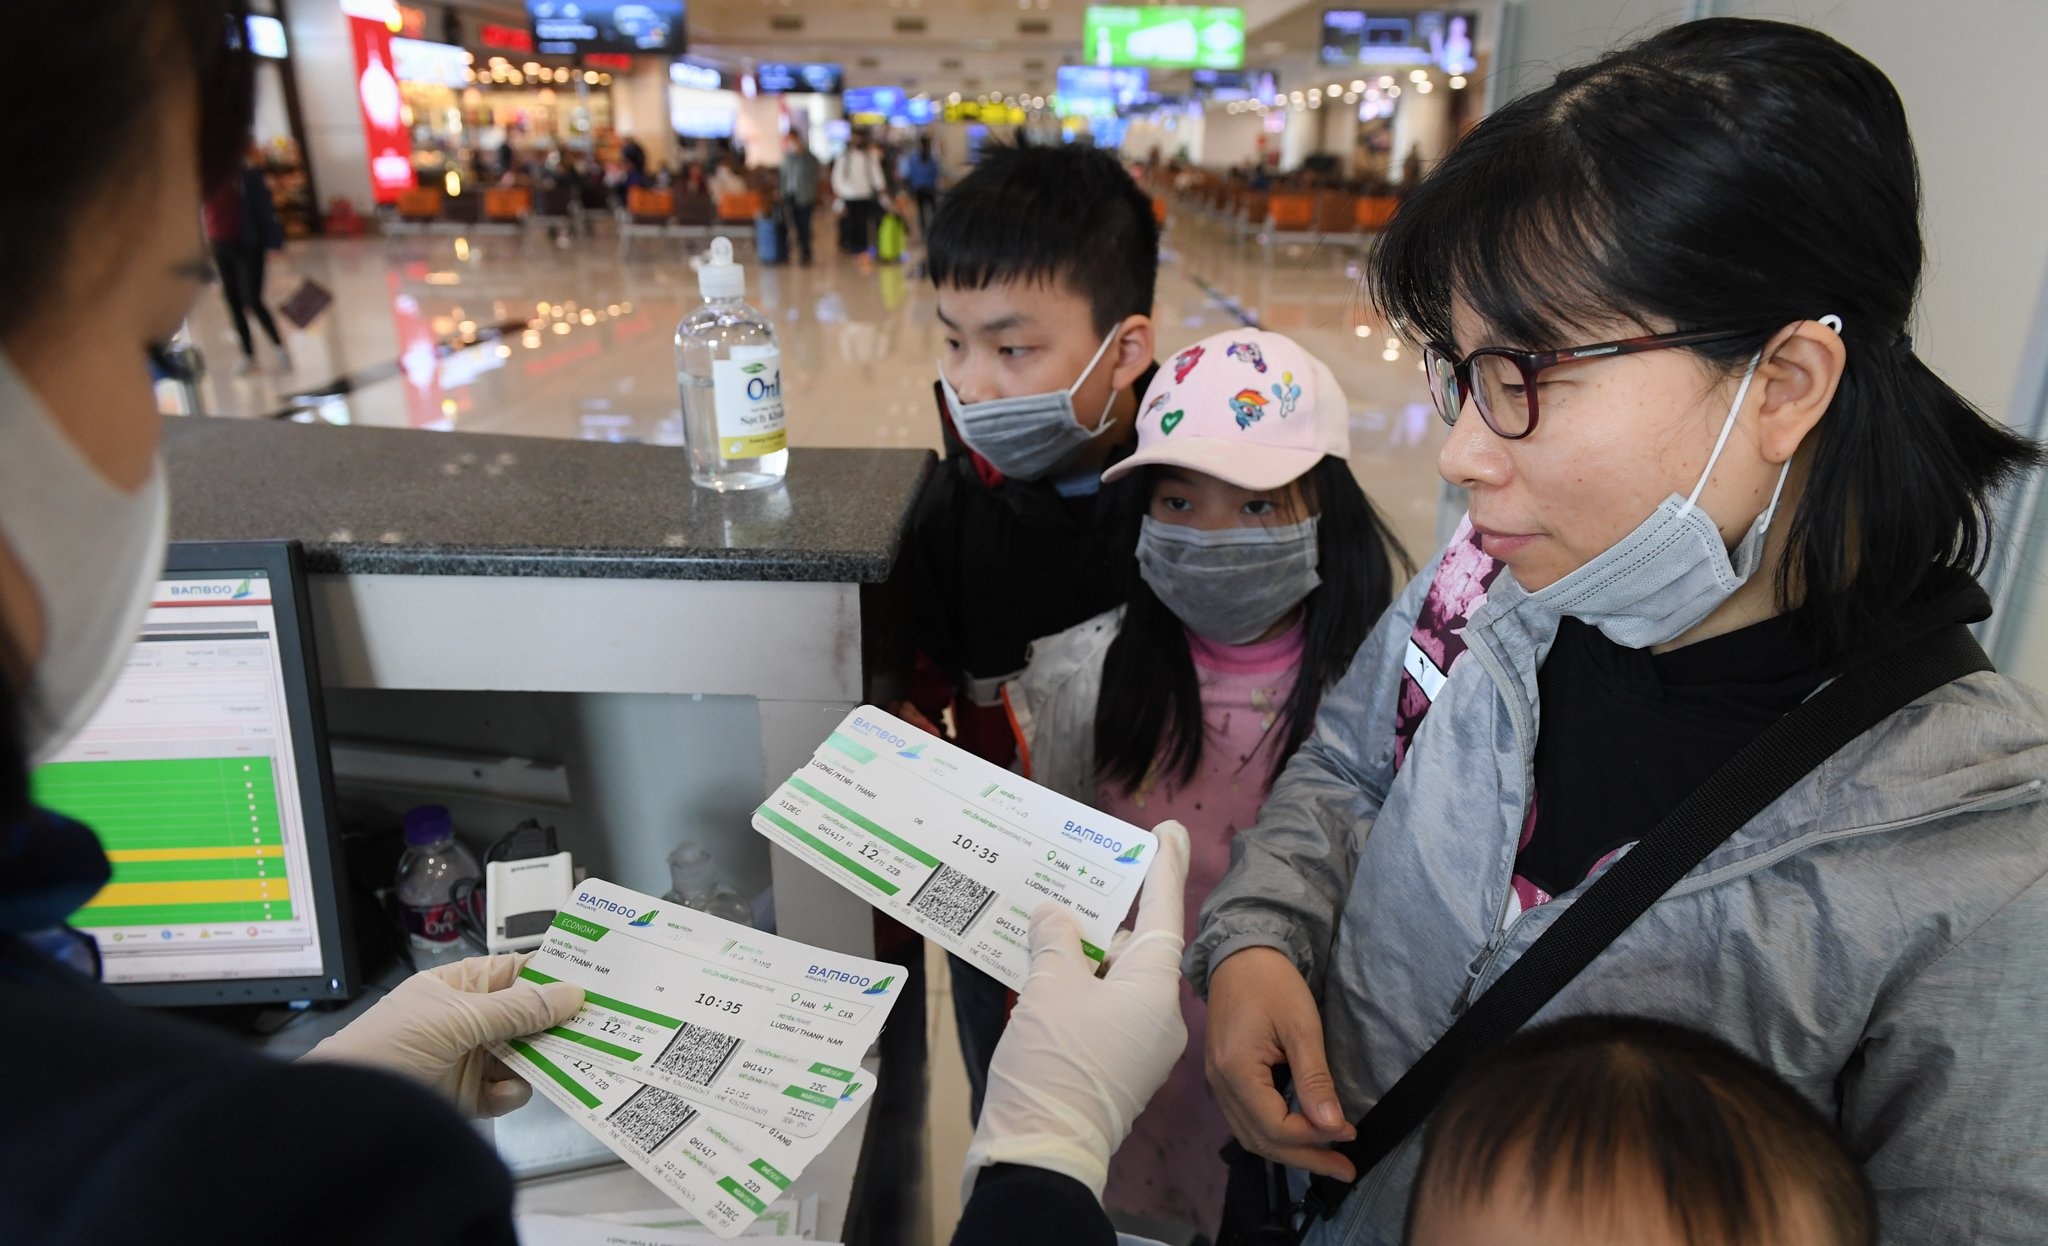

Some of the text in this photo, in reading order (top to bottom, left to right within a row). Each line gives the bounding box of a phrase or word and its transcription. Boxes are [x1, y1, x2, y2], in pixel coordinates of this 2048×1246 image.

[170, 585, 233, 596] BAMBOO
[852, 716, 906, 748] BAMBOO
[811, 759, 853, 785] LUONG/MINH
[854, 783, 877, 799] THANH
[778, 799, 801, 816] 31DEC
[817, 823, 845, 842] QH1417
[1063, 820, 1122, 852] BAMBOO
[952, 833, 999, 864] 10:35
[885, 864, 901, 877] 22B
[1054, 859, 1105, 887] HAN CXR
[575, 901, 596, 912] AIRWAYS
[578, 892, 636, 918] BAMBOO
[1024, 878, 1099, 919] LUONG/MINH THANH
[560, 917, 598, 936] ECONOMY
[995, 916, 1026, 936] QH1417
[976, 940, 1002, 958] 10:35
[542, 945, 610, 975] LUONG/THANH NAM
[804, 974, 828, 984] AIRWAYS
[807, 964, 870, 992] BAMBOO
[694, 992, 742, 1014] 10:35
[799, 999, 854, 1019] HAN CXR
[628, 1034, 644, 1044] 22C
[769, 1020, 843, 1046] LUONG/THANH NAM
[741, 1060, 773, 1075] QH1417
[594, 1078, 609, 1090] 22D
[809, 1081, 827, 1093] 22C
[787, 1106, 815, 1121] 31DEC
[768, 1127, 792, 1146] GIANG
[688, 1136, 716, 1158] QH1417
[663, 1160, 686, 1179] 10:35
[743, 1178, 761, 1193] 22D
[714, 1200, 739, 1222] 31DEC
